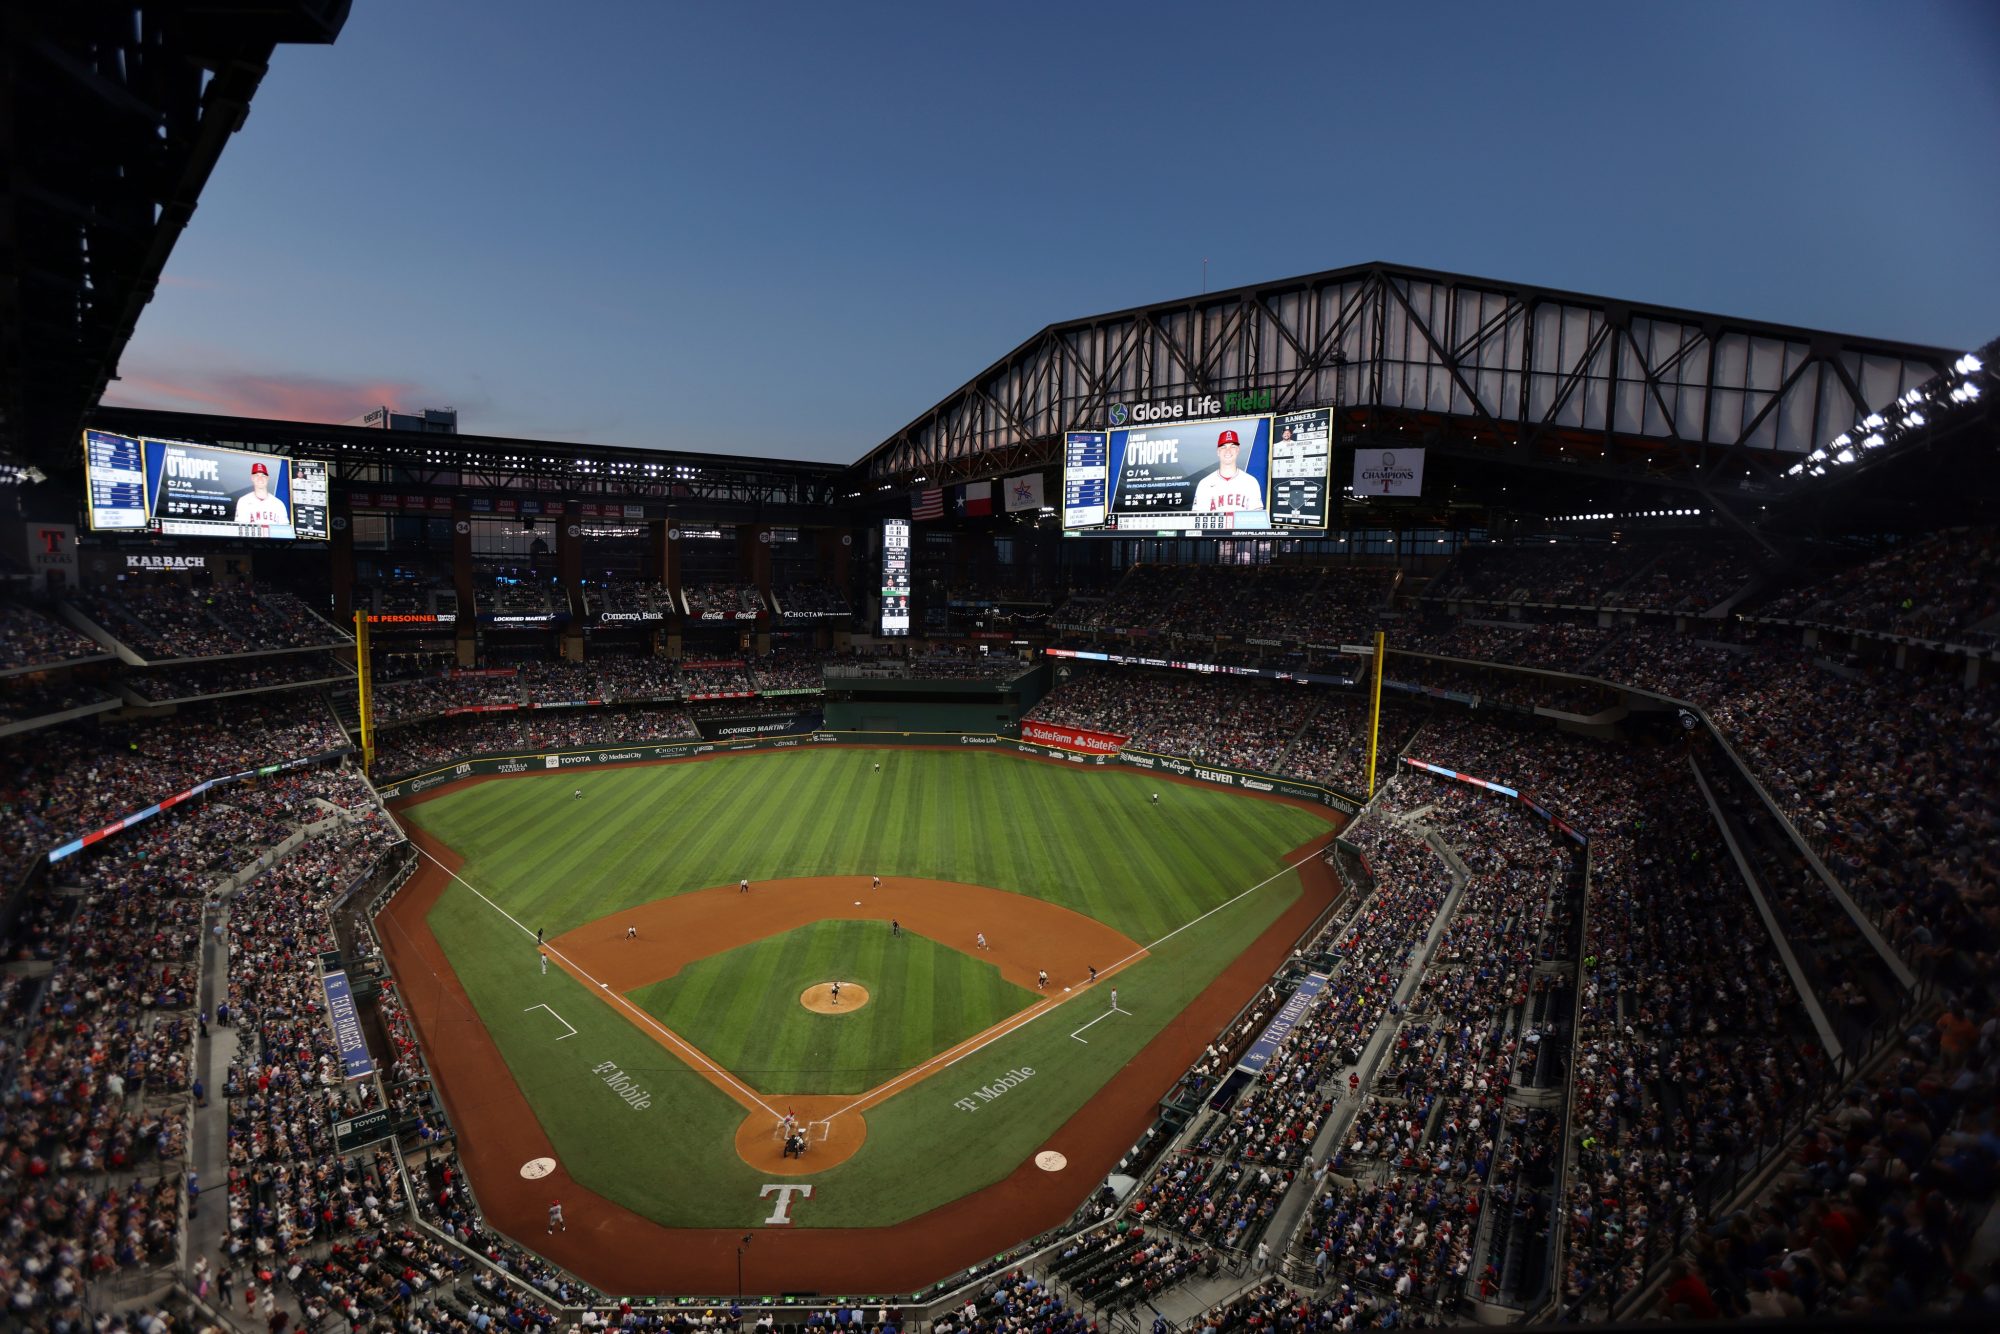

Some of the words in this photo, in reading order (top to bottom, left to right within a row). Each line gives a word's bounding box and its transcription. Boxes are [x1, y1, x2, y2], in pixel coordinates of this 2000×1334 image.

[1132, 402, 1184, 422] Globe
[1187, 395, 1221, 416] Life
[1225, 388, 1271, 413] Field
[1127, 438, 1179, 466] O'HOPPE
[166, 455, 220, 480] O'HOPPE
[1361, 471, 1414, 480] CHAMPIONS
[473, 498, 489, 506] 2010
[523, 500, 537, 508] 2011
[38, 529, 65, 554] T
[36, 555, 73, 565] TEXAS
[126, 555, 205, 568] KARBACH
[381, 614, 437, 623] PERSONNEL
[642, 611, 664, 620] Bank
[788, 610, 824, 618] CHOCTAW
[1056, 623, 1068, 631] UT
[1068, 624, 1099, 633] DALLAS
[790, 687, 821, 695] STAFFING
[718, 726, 756, 735] LOCKHEED
[756, 724, 785, 732] MARTIN
[985, 736, 997, 744] Life
[560, 756, 591, 764] TOYOTA
[630, 752, 642, 760] City
[1127, 753, 1155, 765] National
[456, 763, 471, 775] UTA
[498, 762, 528, 770] ESTRELLA
[1169, 760, 1192, 775] Kroger
[1331, 797, 1355, 815] Mobile
[331, 994, 353, 1018] TEXAS
[1260, 1019, 1291, 1045] TEXAS
[1283, 991, 1312, 1022] RANGERS
[337, 1016, 363, 1052] RANGERS
[601, 1070, 652, 1111] Mobile
[971, 1066, 1037, 1103] Mobile
[353, 1114, 387, 1129] TOYOTA
[760, 1184, 815, 1227] T
